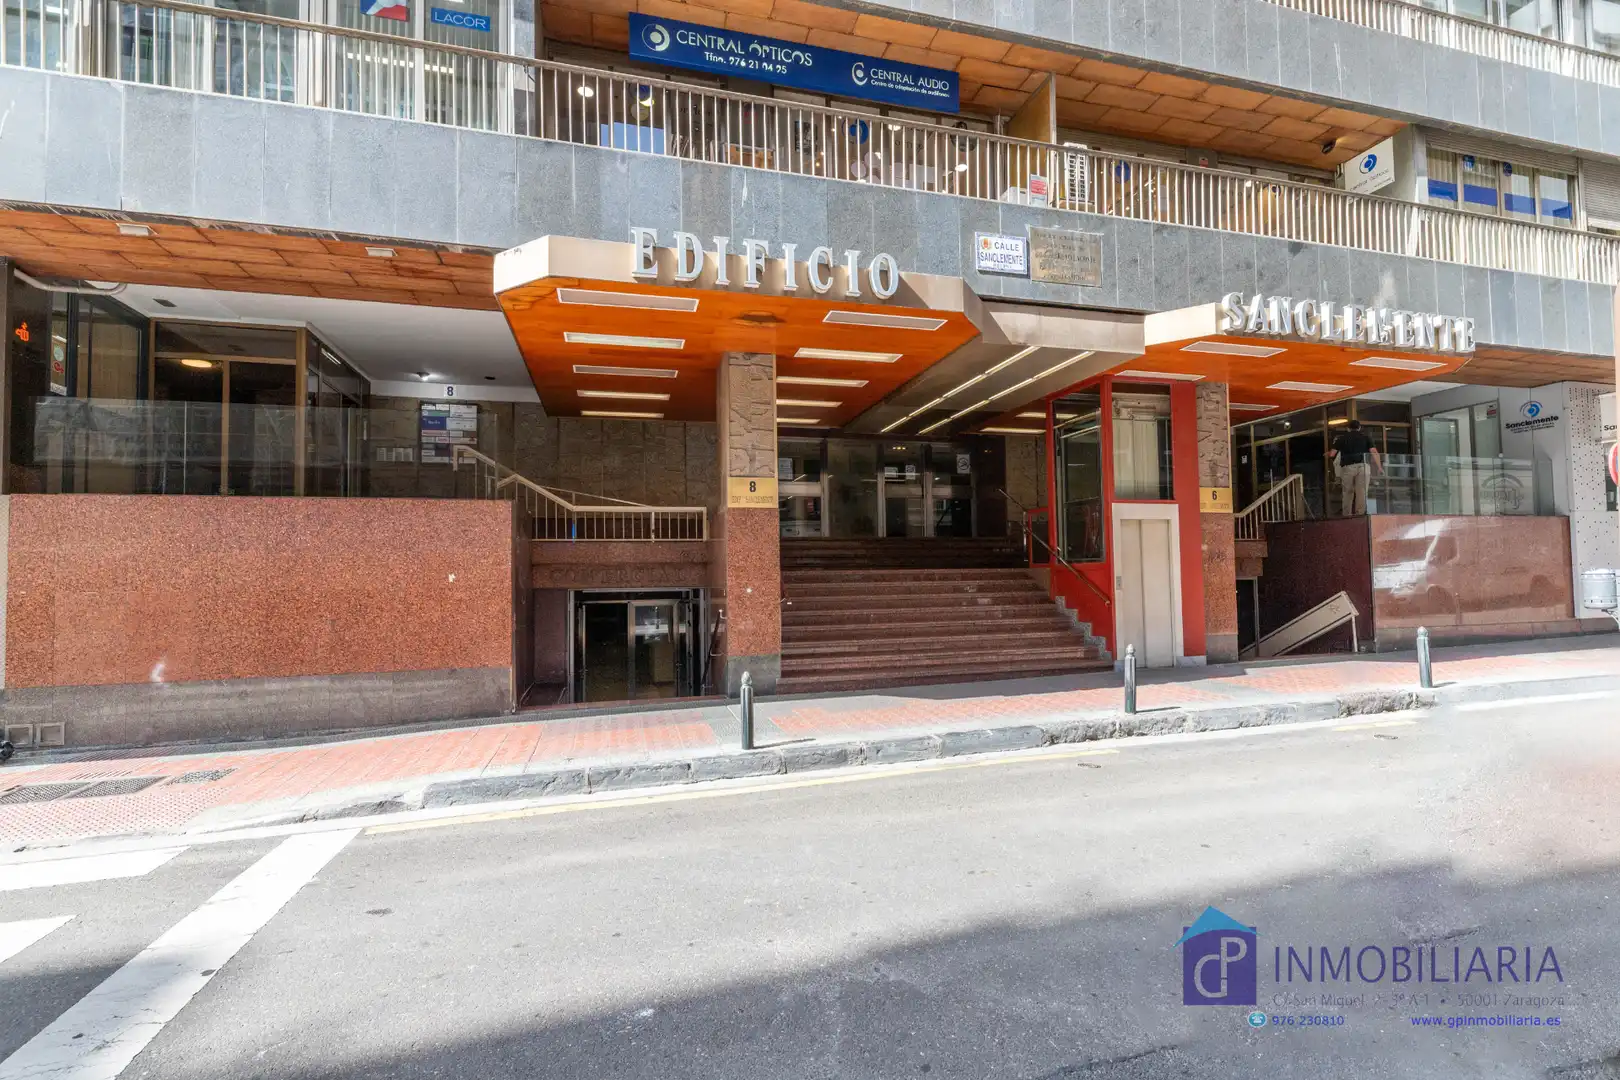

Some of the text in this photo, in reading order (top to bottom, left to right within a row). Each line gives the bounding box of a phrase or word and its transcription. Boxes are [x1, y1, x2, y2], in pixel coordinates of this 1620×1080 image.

[434, 11, 486, 29] LACOR
[676, 29, 813, 67] CENTRAL ÓPTICOS
[748, 59, 759, 69] 21
[870, 68, 950, 91] CENTRAL AUDIO
[994, 241, 1020, 252] CALLE
[631, 226, 899, 300] EDIFICIO
[979, 251, 1023, 266] SANCLEMENTE
[1221, 291, 1476, 353] SANCLEMENTE
[446, 386, 454, 397] 8
[1505, 415, 1559, 429] Sanclemente
[749, 480, 757, 493] 8
[1211, 490, 1218, 501] 6
